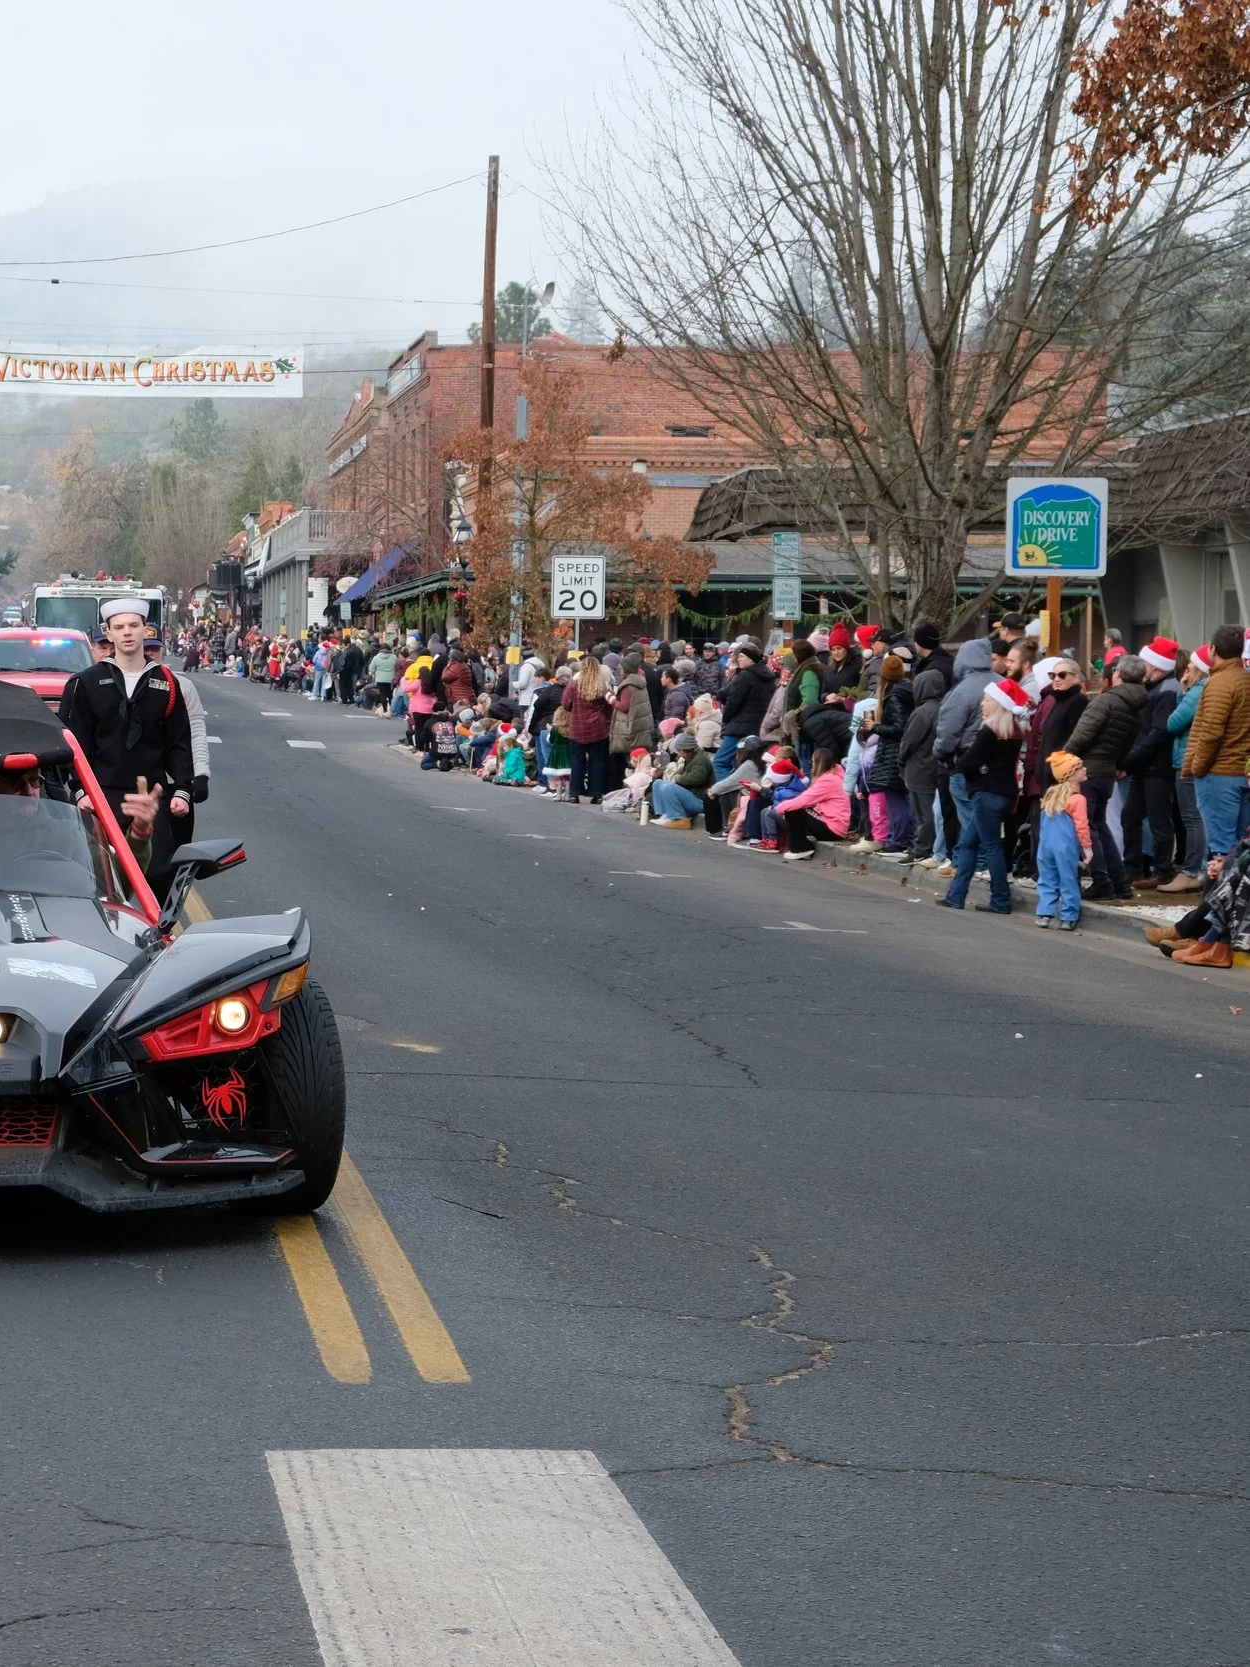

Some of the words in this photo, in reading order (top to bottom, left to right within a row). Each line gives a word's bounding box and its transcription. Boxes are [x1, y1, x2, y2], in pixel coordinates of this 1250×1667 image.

[133, 357, 276, 387] CHRISTMAS
[1023, 510, 1092, 526] DISCOVERY
[1037, 527, 1078, 542] DRIVE
[558, 563, 600, 573] SPEED
[561, 576, 595, 586] LIMIT
[558, 589, 598, 611] 20
